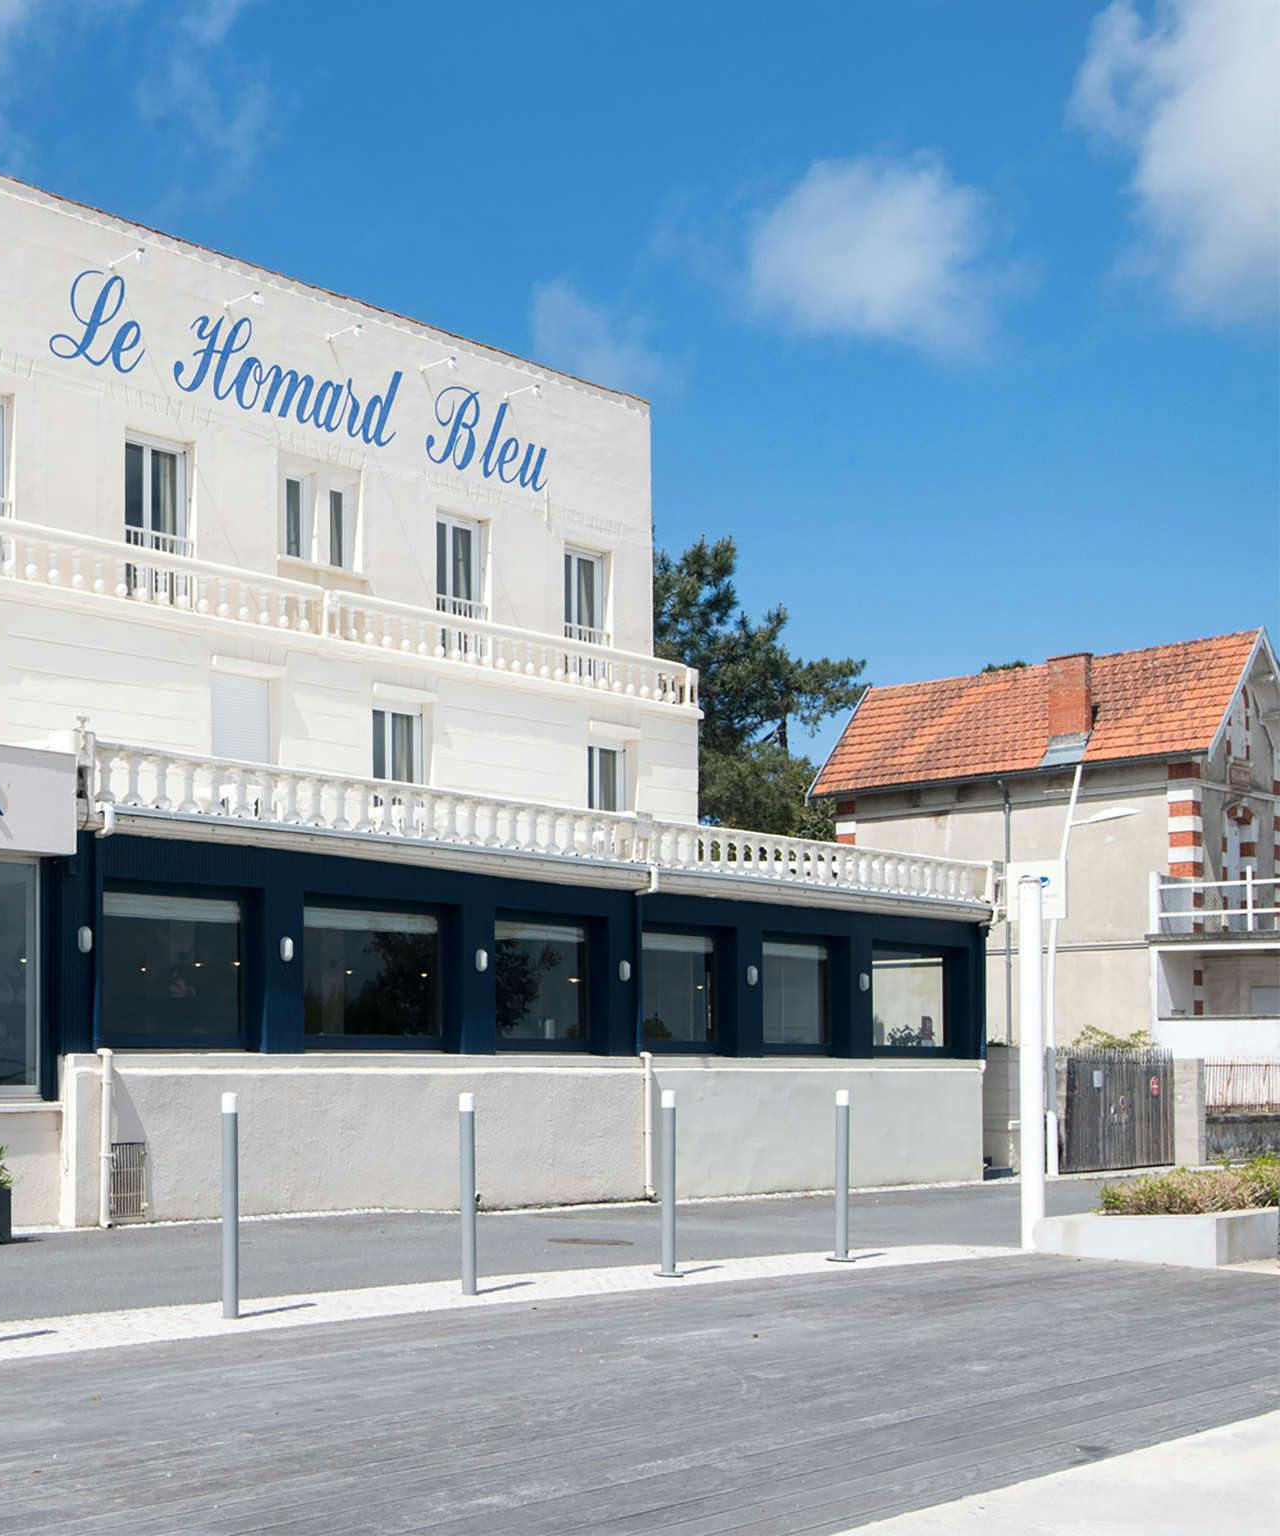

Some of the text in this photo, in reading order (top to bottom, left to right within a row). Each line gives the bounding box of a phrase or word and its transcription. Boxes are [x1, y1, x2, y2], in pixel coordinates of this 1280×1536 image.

[49, 269, 548, 492] Le Homard Bleu
